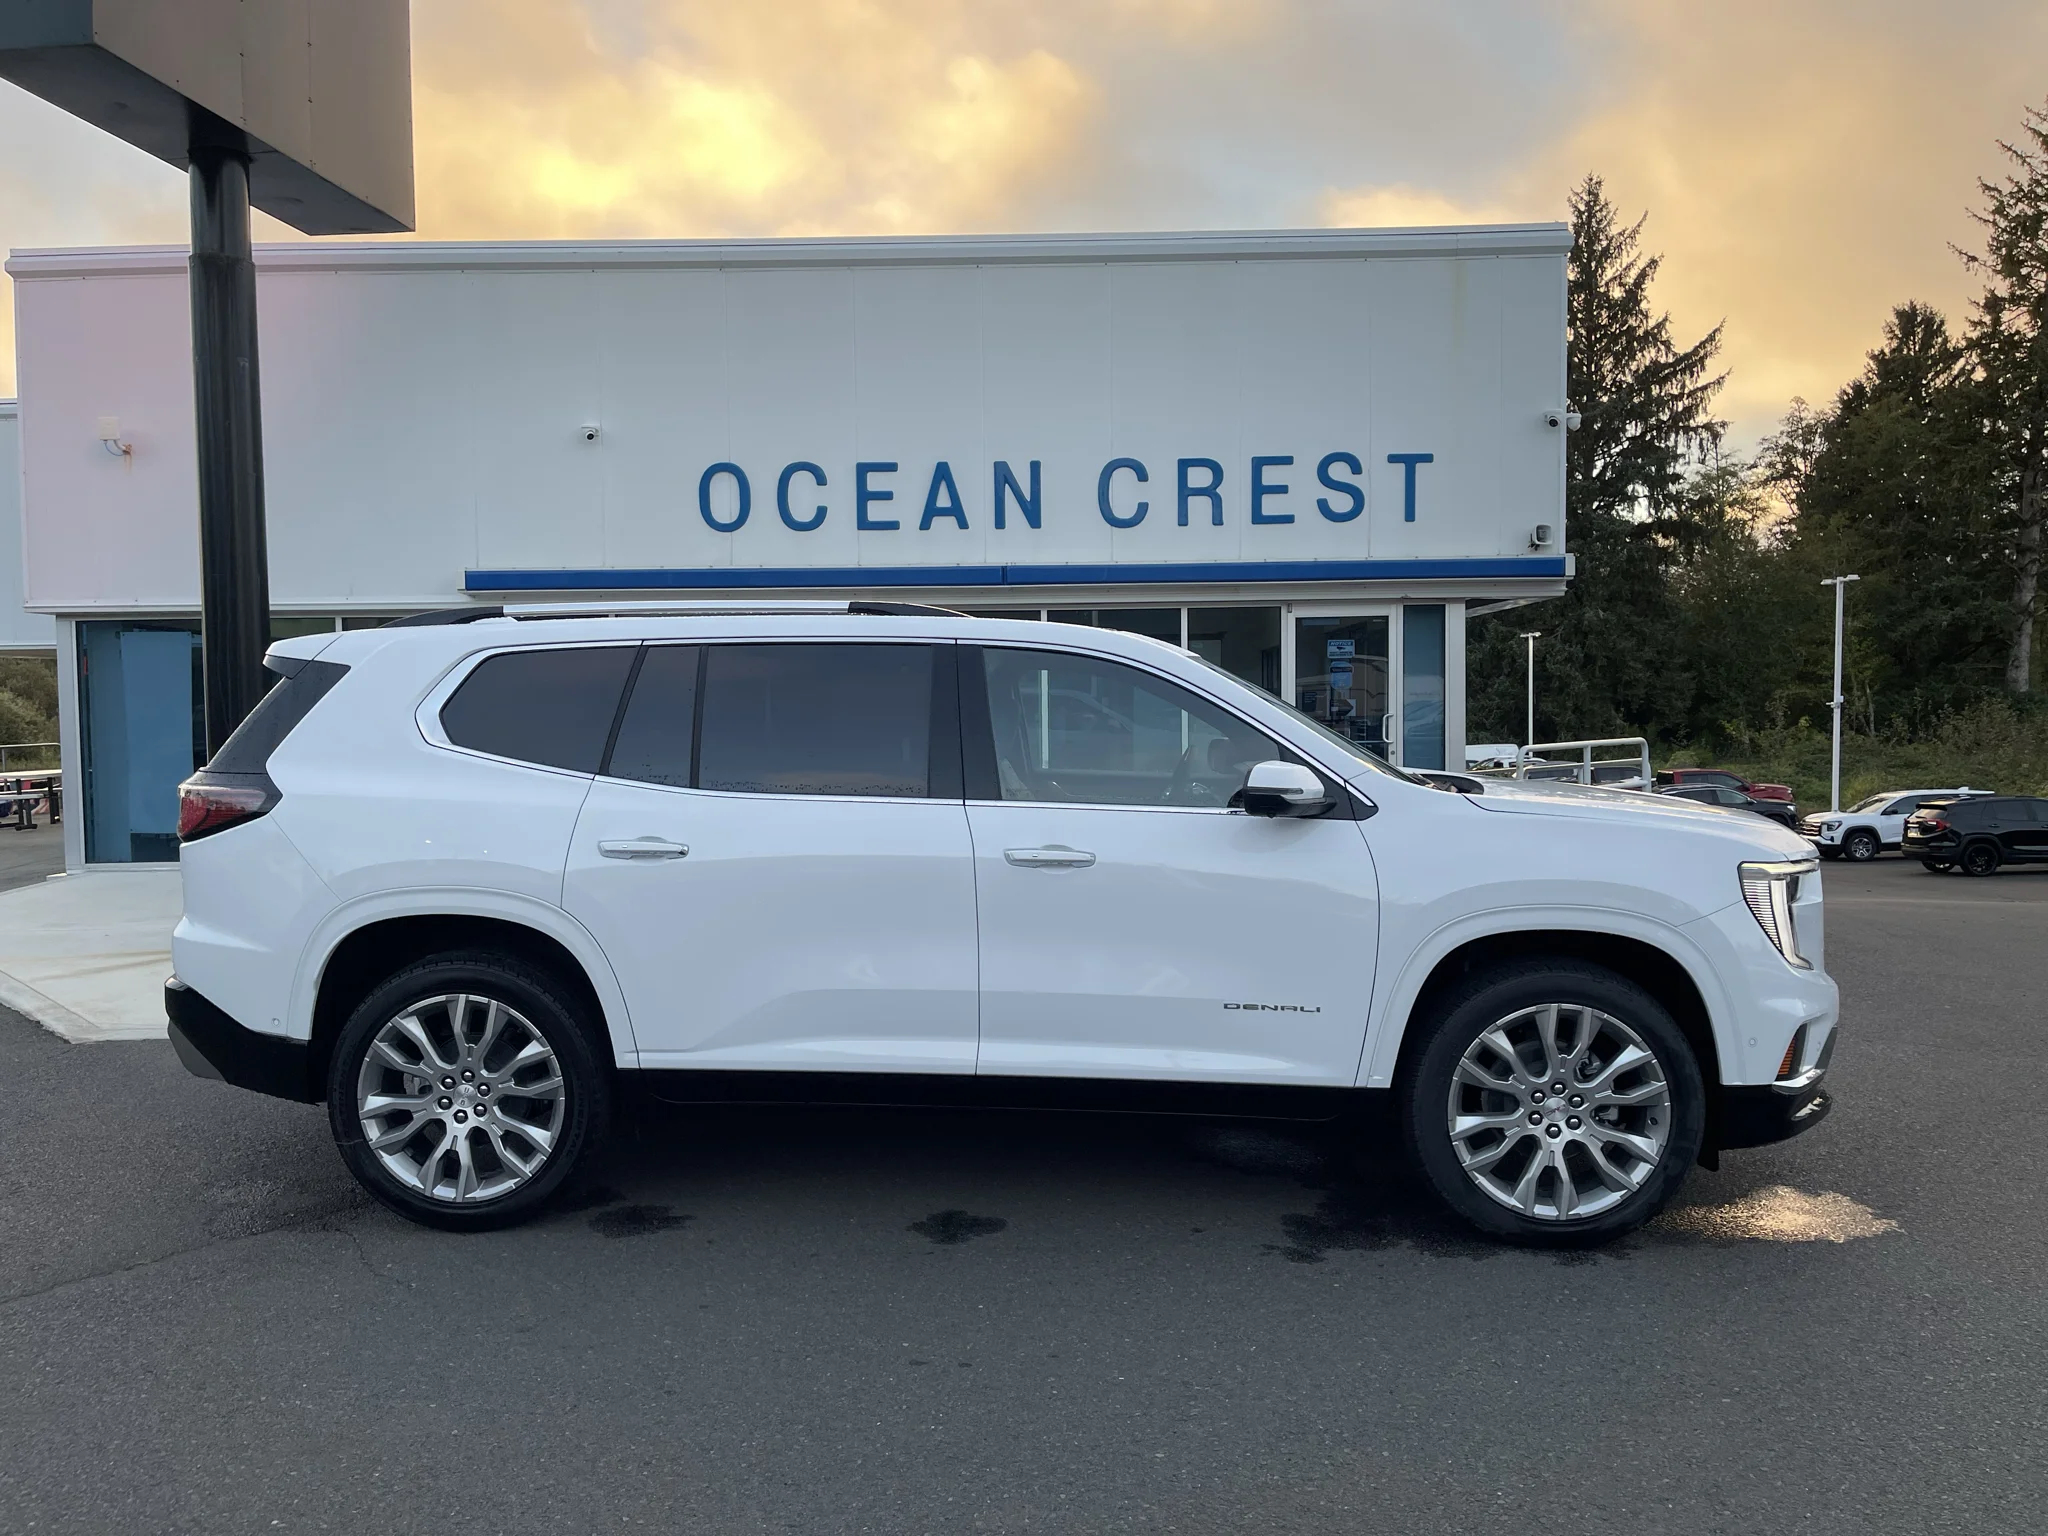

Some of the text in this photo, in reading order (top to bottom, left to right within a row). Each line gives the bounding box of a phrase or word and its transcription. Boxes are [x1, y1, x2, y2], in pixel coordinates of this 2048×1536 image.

[699, 452, 1434, 532] OCEAN CREST
[1223, 1003, 1321, 1013] DENALI
